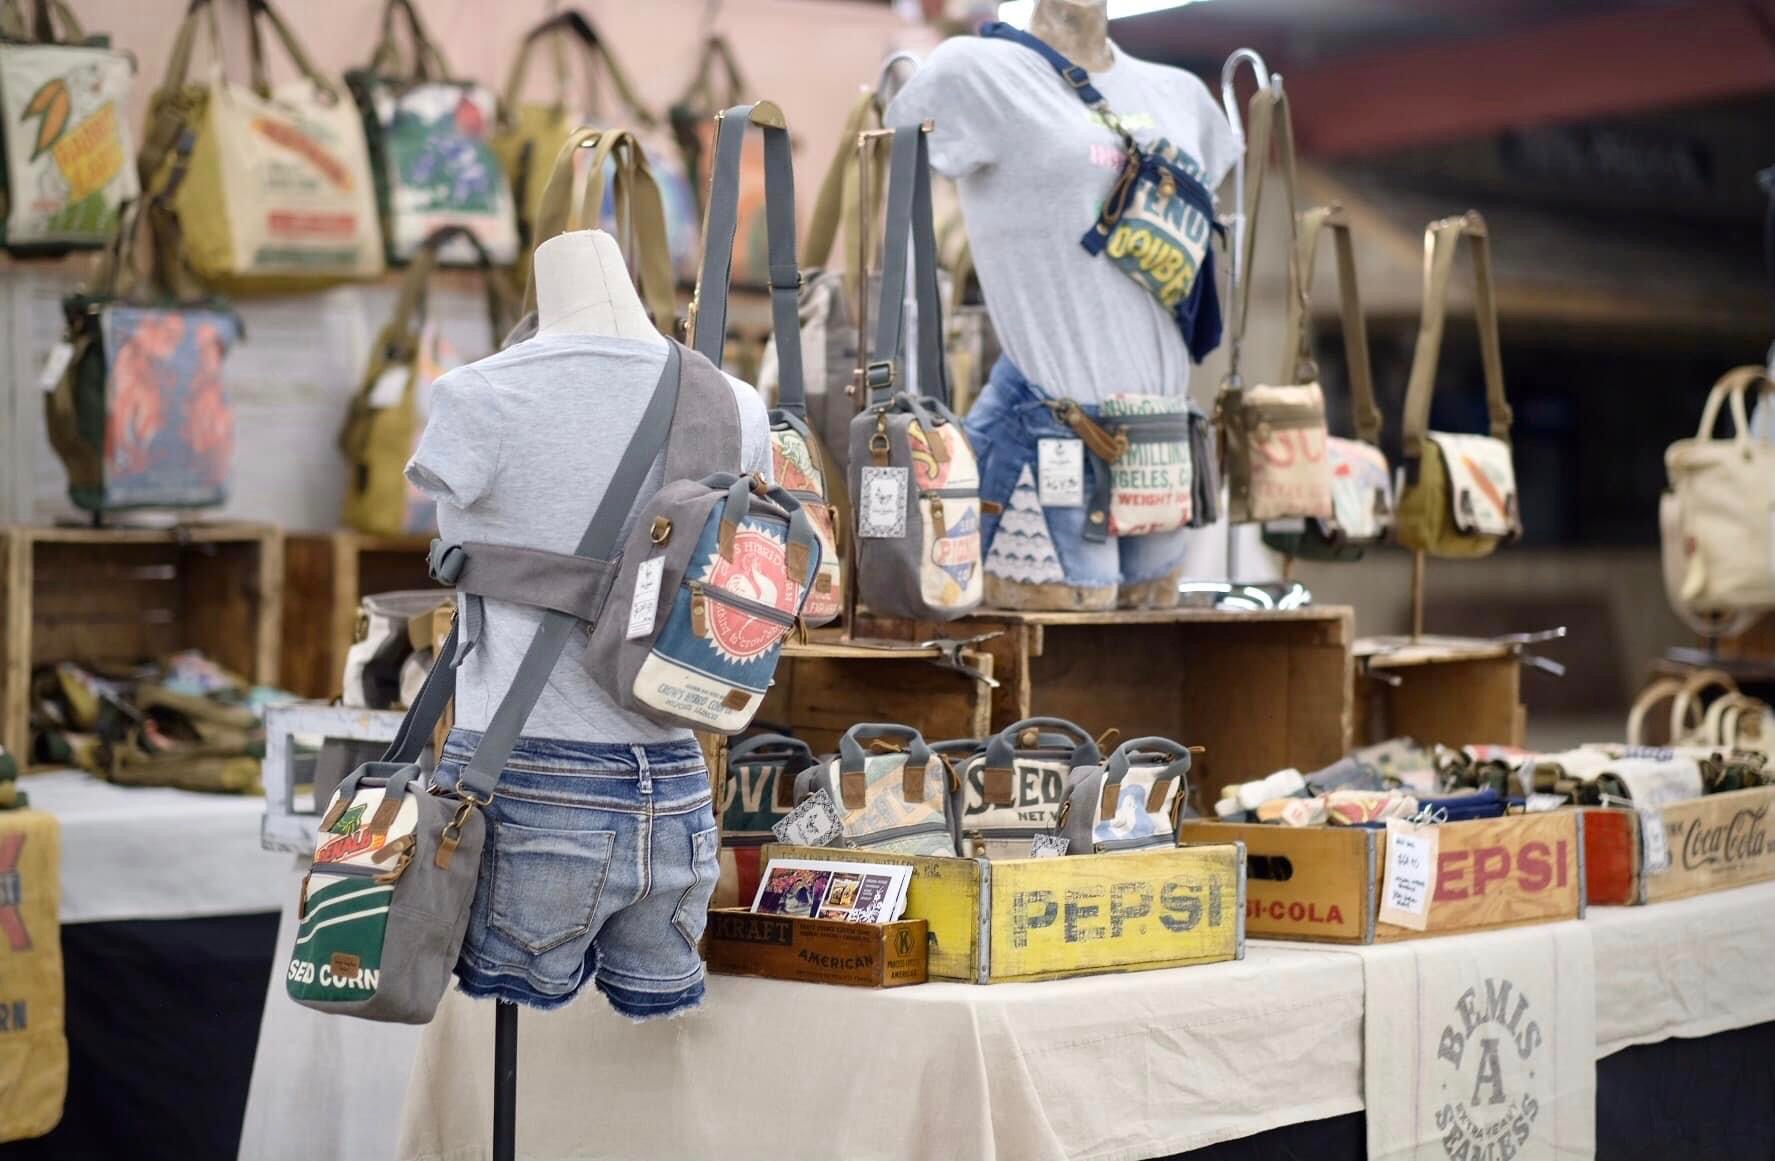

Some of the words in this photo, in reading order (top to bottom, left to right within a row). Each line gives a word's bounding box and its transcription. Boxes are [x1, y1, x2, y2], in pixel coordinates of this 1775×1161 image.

[964, 765, 1063, 816] SED
[1018, 811, 1044, 822] NET
[1682, 799, 1768, 871] Coca-Cola
[1433, 840, 1568, 901] EPSI
[714, 918, 789, 942] KRAFT
[1012, 872, 1223, 948] PEPSI
[320, 964, 379, 990] CORN
[799, 949, 873, 970] AMERICAN
[1438, 977, 1542, 1071] BEMIS
[1470, 1037, 1507, 1107] A
